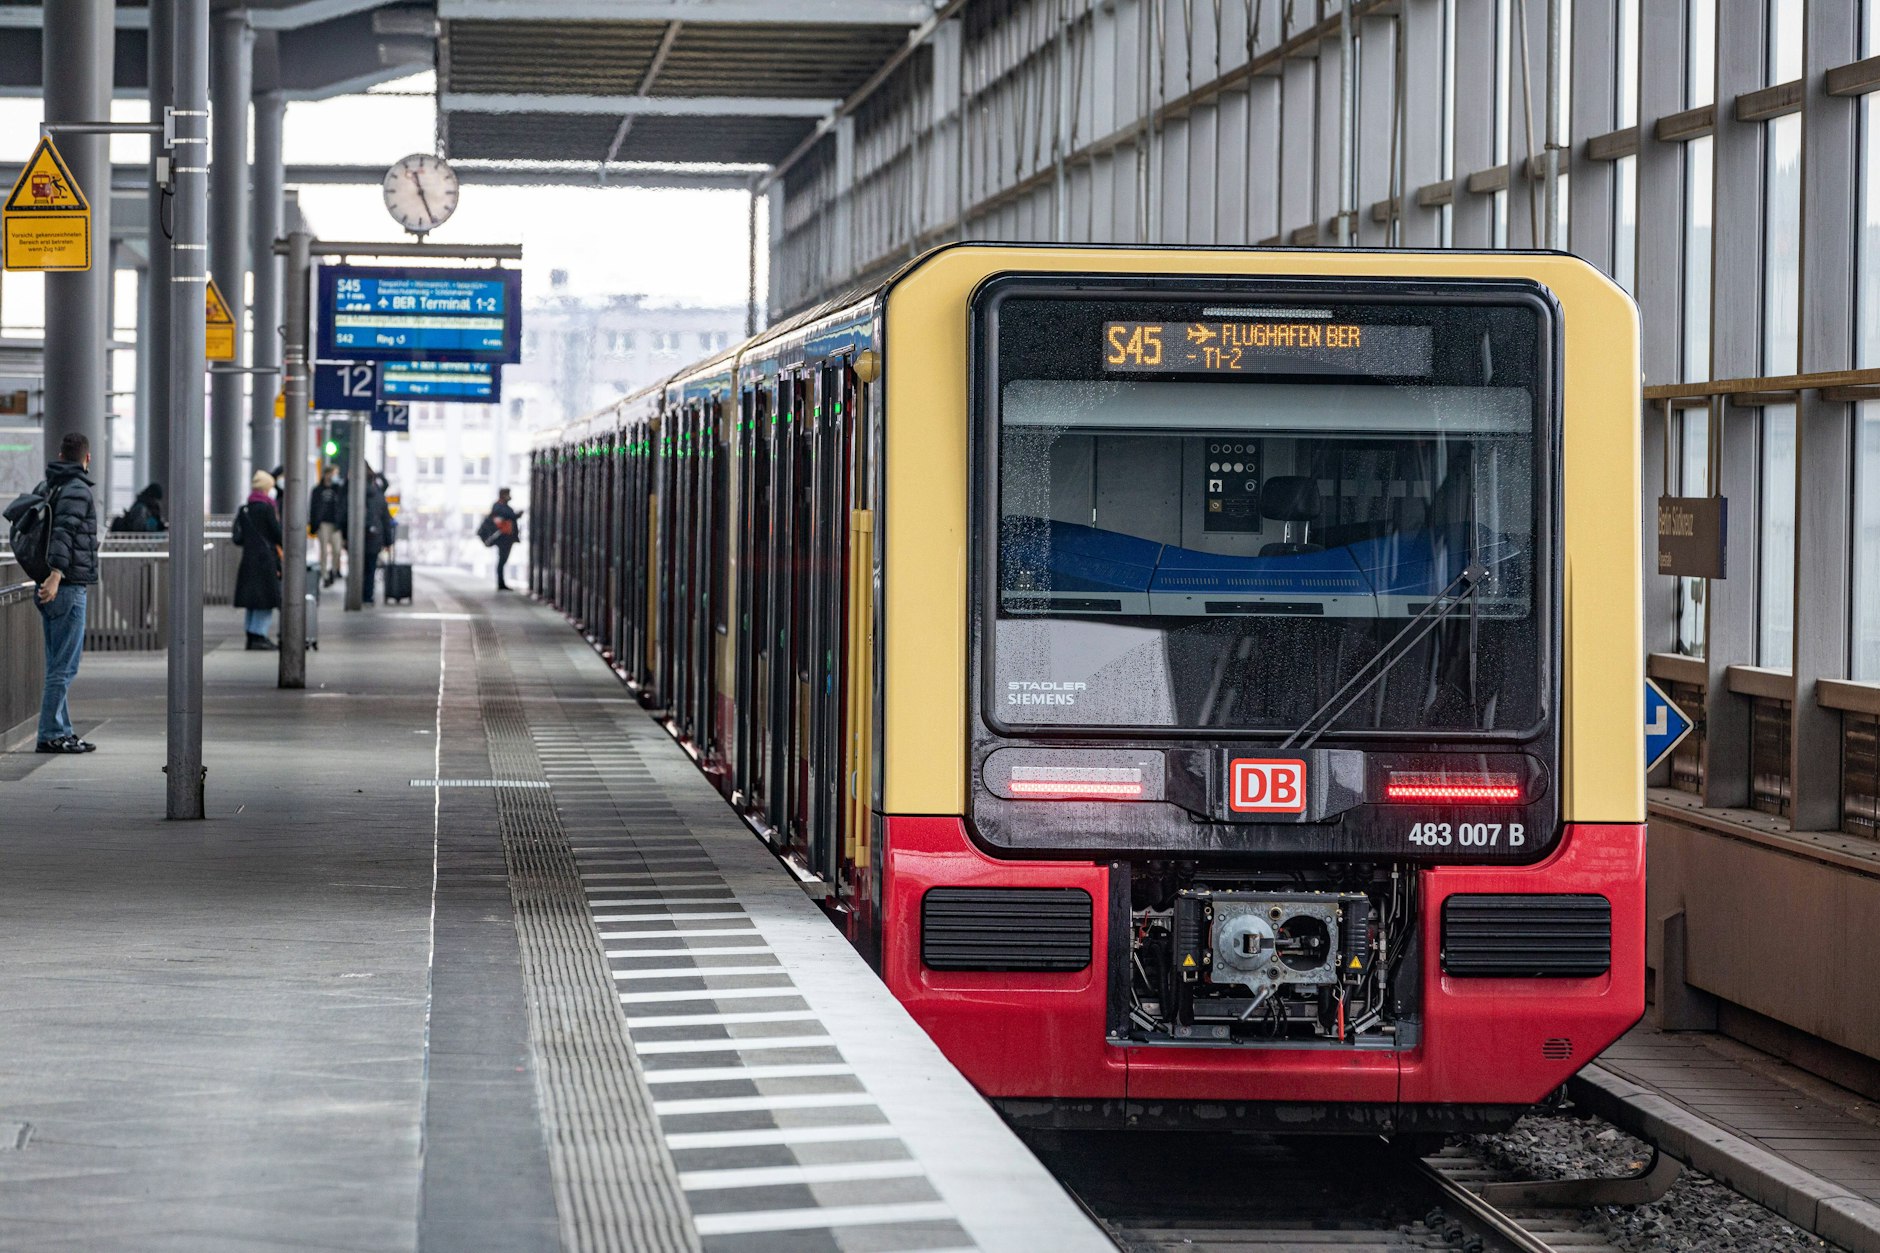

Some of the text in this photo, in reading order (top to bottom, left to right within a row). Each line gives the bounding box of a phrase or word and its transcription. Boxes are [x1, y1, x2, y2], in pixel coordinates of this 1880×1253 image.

[337, 279, 361, 292] S45
[392, 296, 497, 311] BER Terminal 1-2
[376, 333, 395, 345] Ring
[1107, 326, 1163, 365] S45
[1221, 323, 1361, 348] FLUGHAFEN BER
[1202, 347, 1242, 369] T1-2
[336, 365, 373, 397] 12
[383, 407, 408, 425] 12
[1008, 681, 1087, 691] STADLER
[1008, 693, 1075, 705] SIEMENS
[1240, 767, 1297, 804] DB
[1408, 822, 1525, 847] 483 007 B
